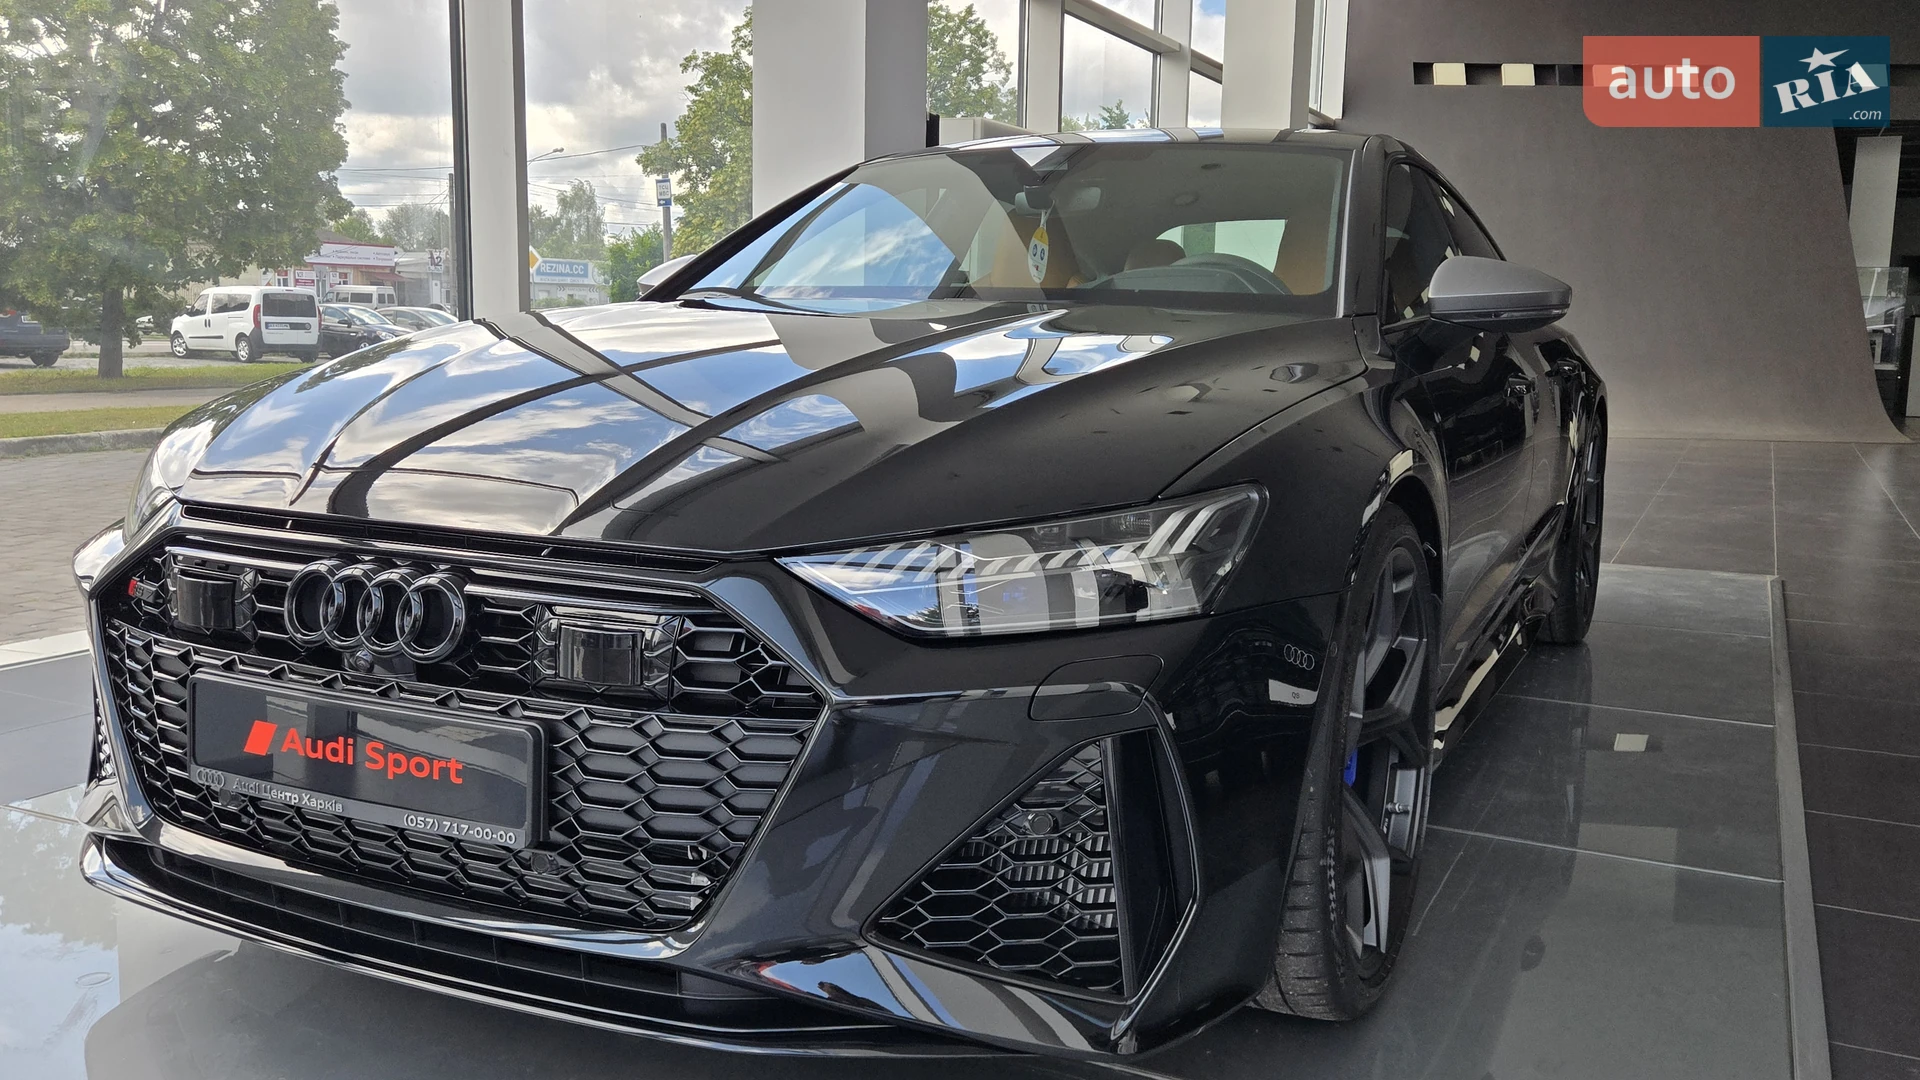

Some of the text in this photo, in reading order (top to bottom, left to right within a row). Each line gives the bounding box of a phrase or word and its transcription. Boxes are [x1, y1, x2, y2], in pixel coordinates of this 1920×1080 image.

[540, 262, 584, 275] REZINA.CC
[281, 727, 464, 784] Audi Sport
[232, 777, 344, 813] Audi Центр Харків
[403, 813, 517, 845] (057) 717-00-00
